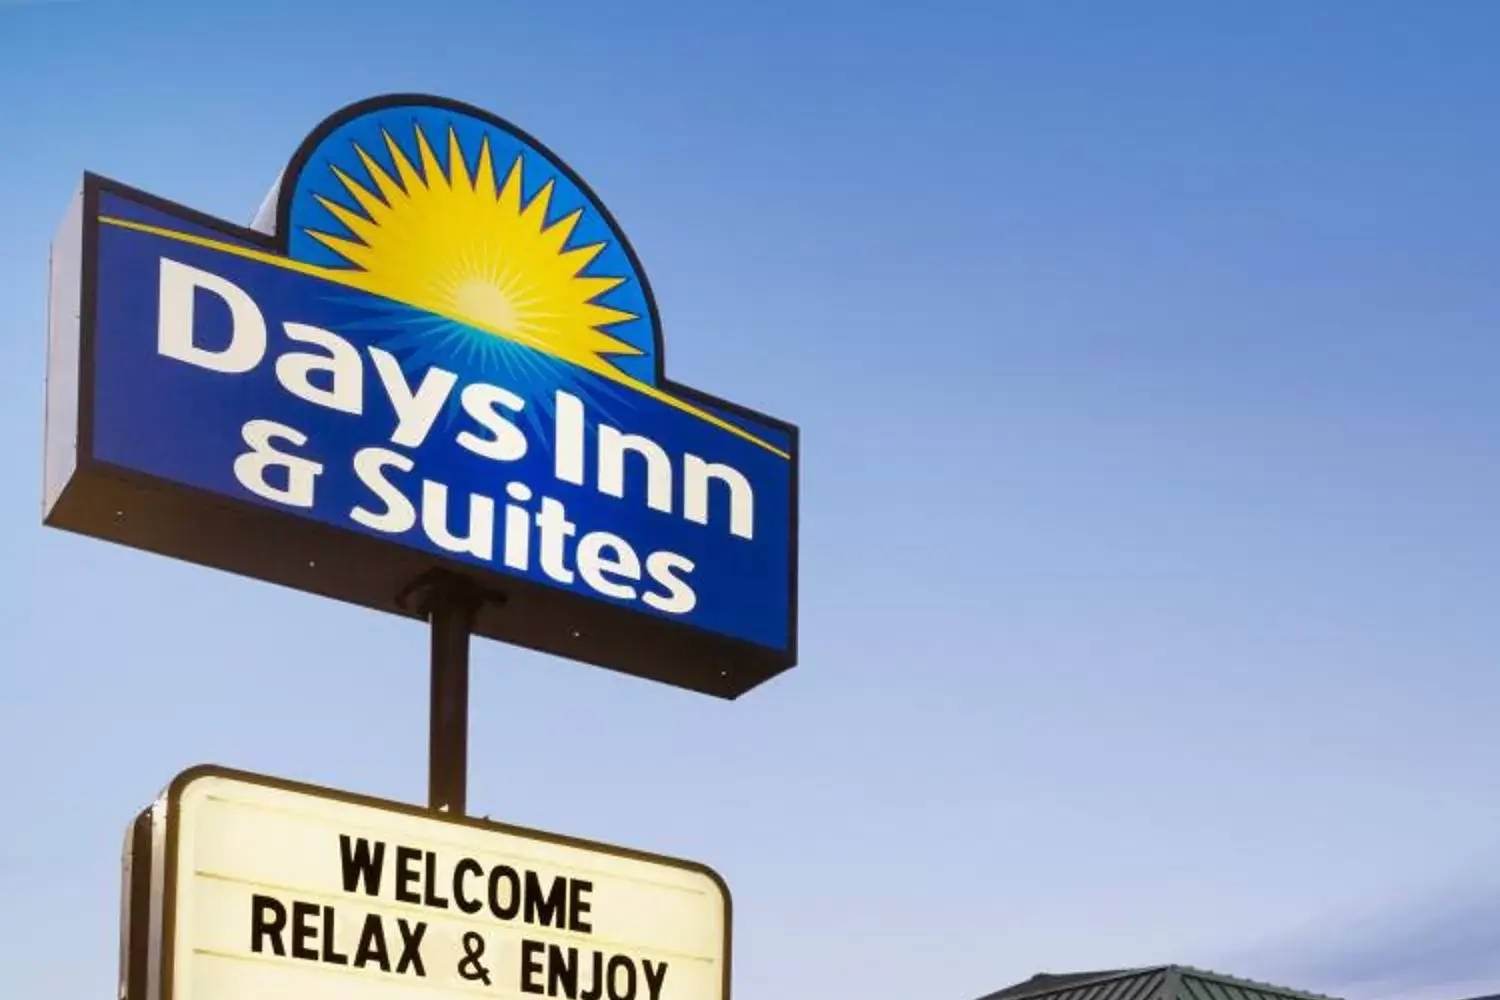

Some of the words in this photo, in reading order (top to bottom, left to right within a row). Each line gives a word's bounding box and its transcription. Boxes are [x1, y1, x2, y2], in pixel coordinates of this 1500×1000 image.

[233, 419, 323, 508] &
[350, 447, 697, 614] Suites
[339, 834, 594, 934] WELCOME
[250, 894, 428, 978] RELAX
[457, 931, 492, 987] &
